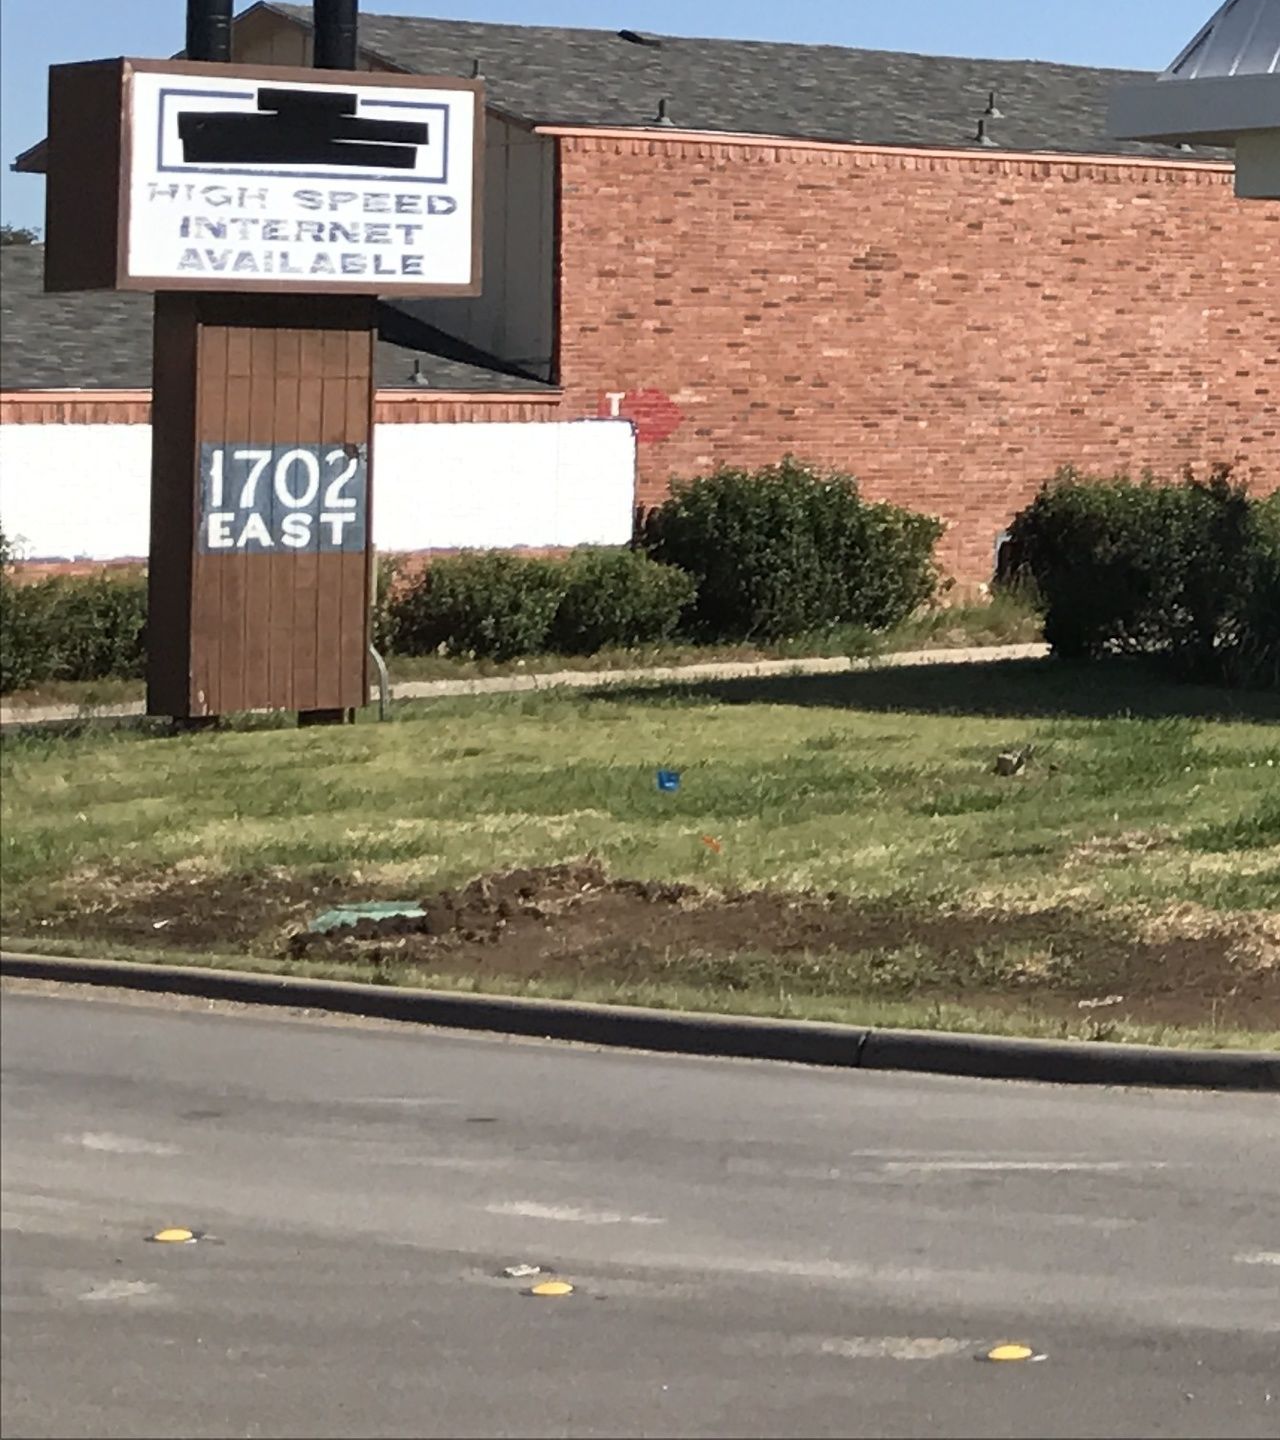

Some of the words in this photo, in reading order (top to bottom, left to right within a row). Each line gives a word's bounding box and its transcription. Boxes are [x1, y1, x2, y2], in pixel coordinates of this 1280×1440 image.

[147, 182, 269, 210] HIGH
[292, 189, 458, 216] SPEED
[178, 215, 424, 246] INTERNET
[176, 247, 425, 276] AVAILABLE
[209, 448, 358, 509] 1702
[207, 512, 357, 549] EAST
